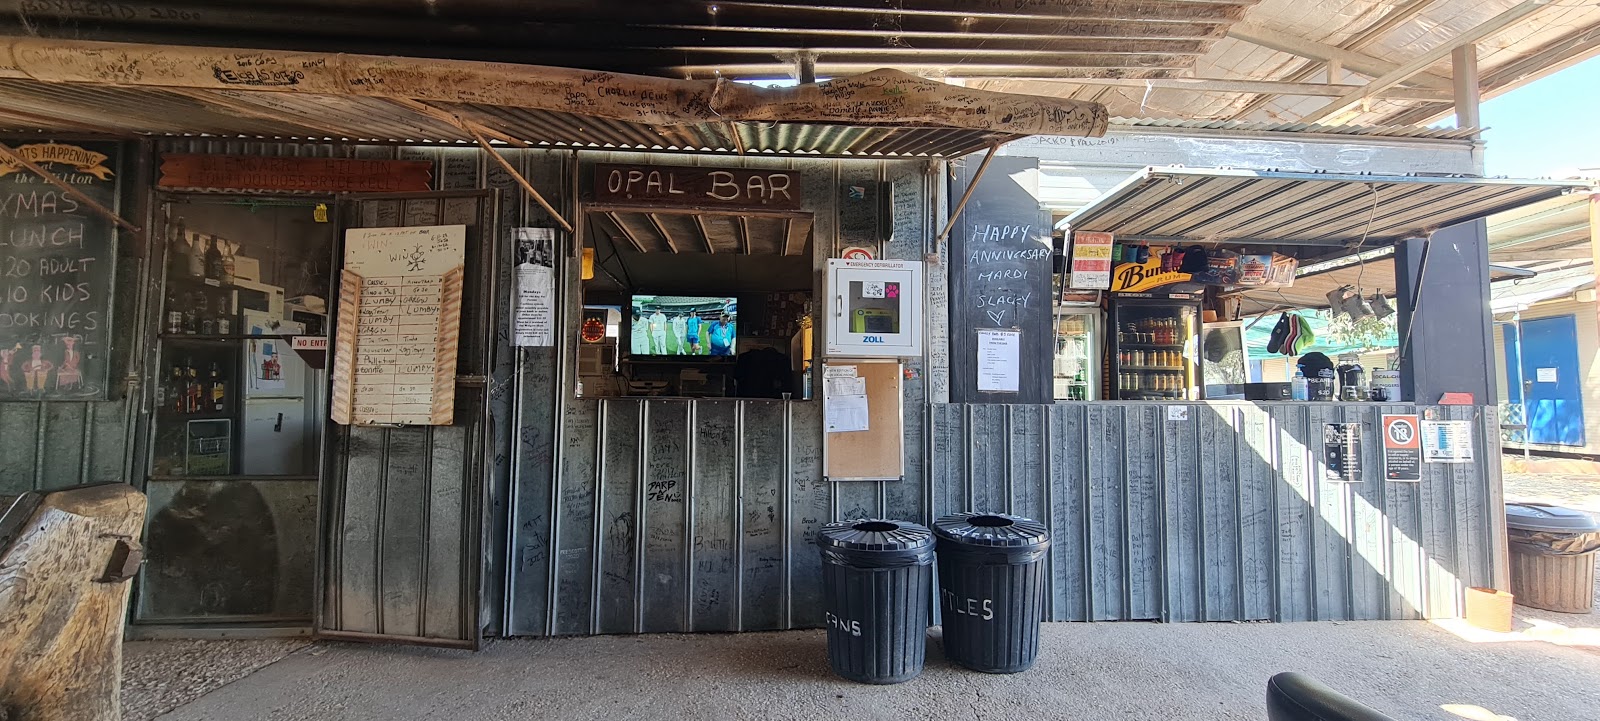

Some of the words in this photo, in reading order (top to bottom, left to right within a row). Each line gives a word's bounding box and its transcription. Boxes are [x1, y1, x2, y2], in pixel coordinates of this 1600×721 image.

[1, 147, 38, 165] WATS
[42, 146, 97, 166] HAPPENING
[41, 161, 54, 170] at
[325, 159, 392, 175] HILTON
[15, 172, 35, 184] the
[310, 176, 354, 189] BRYCE
[360, 177, 404, 190] KELLY
[608, 169, 685, 194] OPAL
[706, 171, 791, 201] BAR
[972, 224, 1031, 243] HAPPY
[389, 253, 408, 263] WIN
[970, 248, 1051, 265] ANNIVERSARY
[40, 257, 95, 277] ADULT
[978, 269, 1028, 282] MARDI
[1156, 274, 1181, 283] RUM
[40, 282, 91, 304] KIDS
[365, 297, 396, 305] LUMBY
[407, 307, 435, 315] LUMBY
[362, 317, 393, 325] LUMBY
[297, 339, 307, 347] NO
[1394, 428, 1407, 440] 18
[648, 492, 673, 502] JEN
[826, 610, 862, 637] CANS
